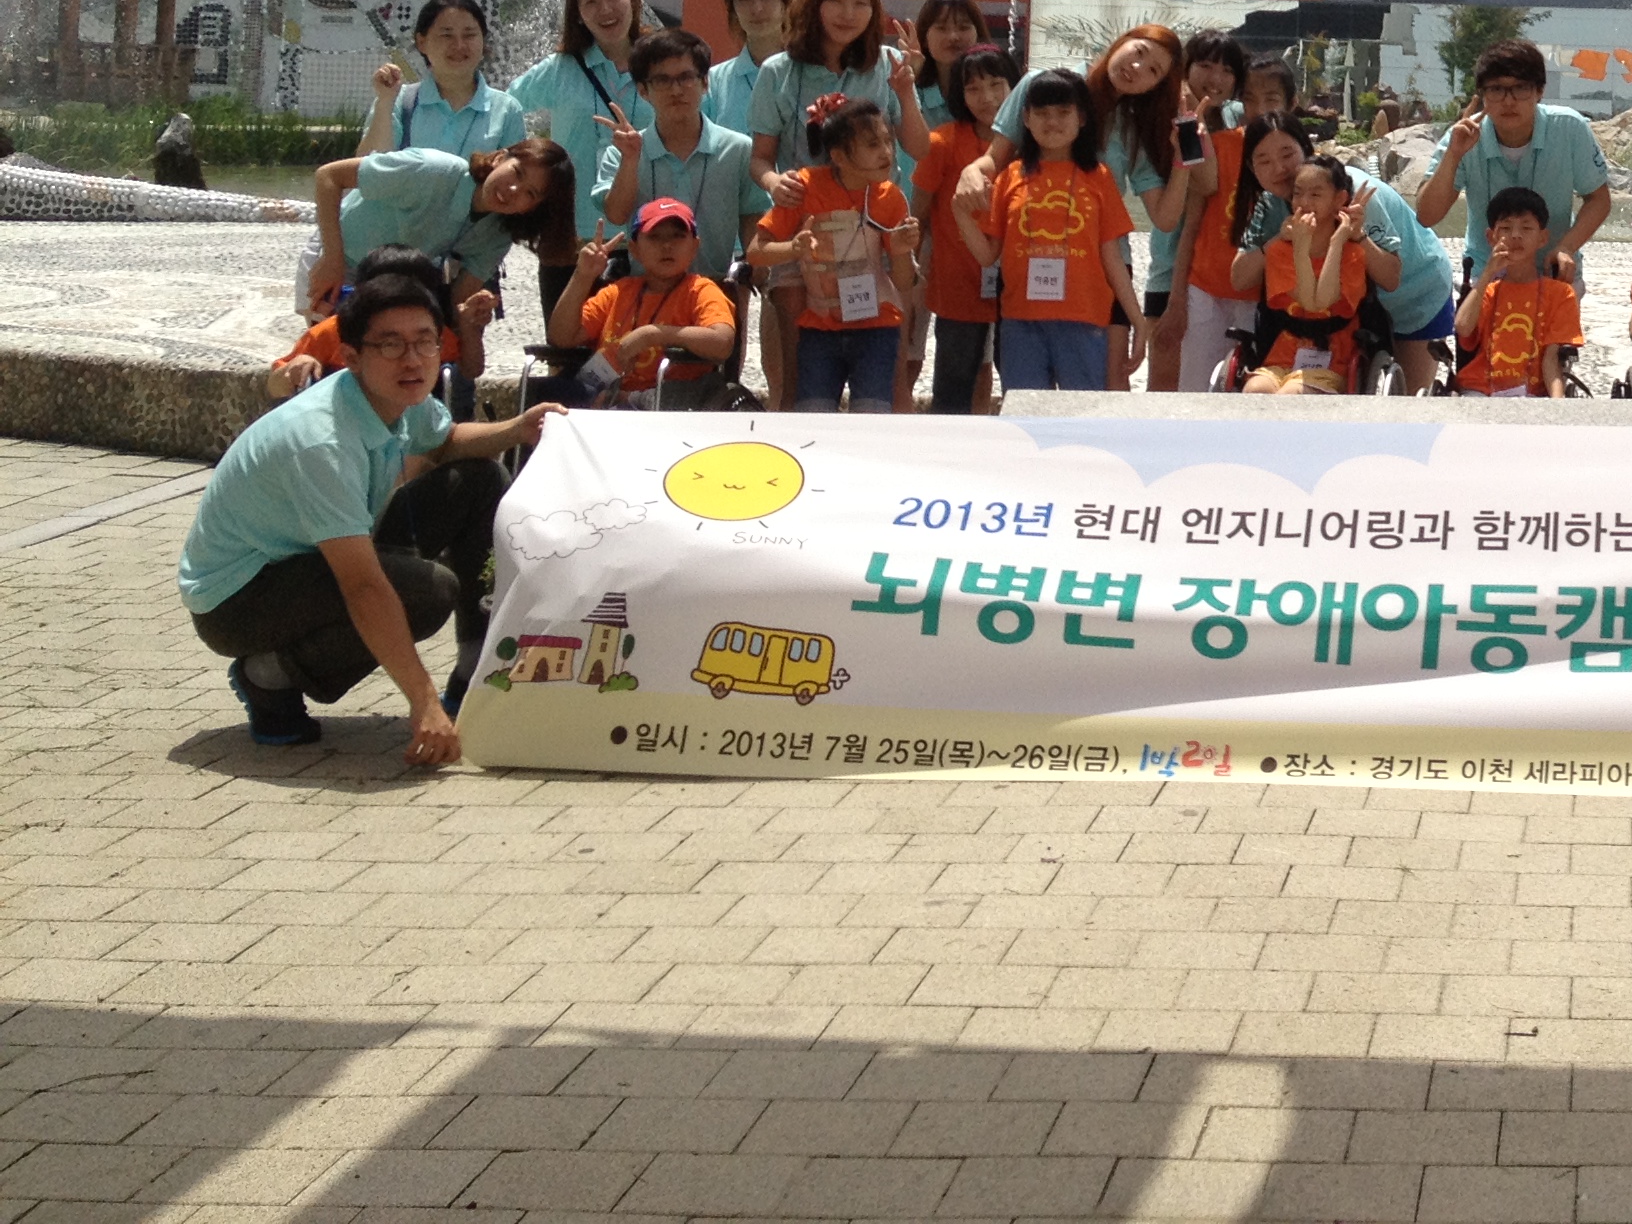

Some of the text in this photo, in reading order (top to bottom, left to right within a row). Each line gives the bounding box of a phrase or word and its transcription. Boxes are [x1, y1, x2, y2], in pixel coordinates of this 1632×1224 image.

[732, 531, 808, 549] SUNNY
[893, 496, 1054, 537] 2013년
[1073, 503, 1161, 543] 현대
[1181, 507, 1455, 550] 엔지니어링과
[850, 551, 1141, 650] 뇌병변
[635, 723, 688, 754] 일시
[718, 729, 814, 761] 2013년
[824, 733, 868, 764] 7월
[1283, 752, 1336, 777] 장소
[1369, 755, 1449, 780] 경기도
[1461, 759, 1513, 783] 이천
